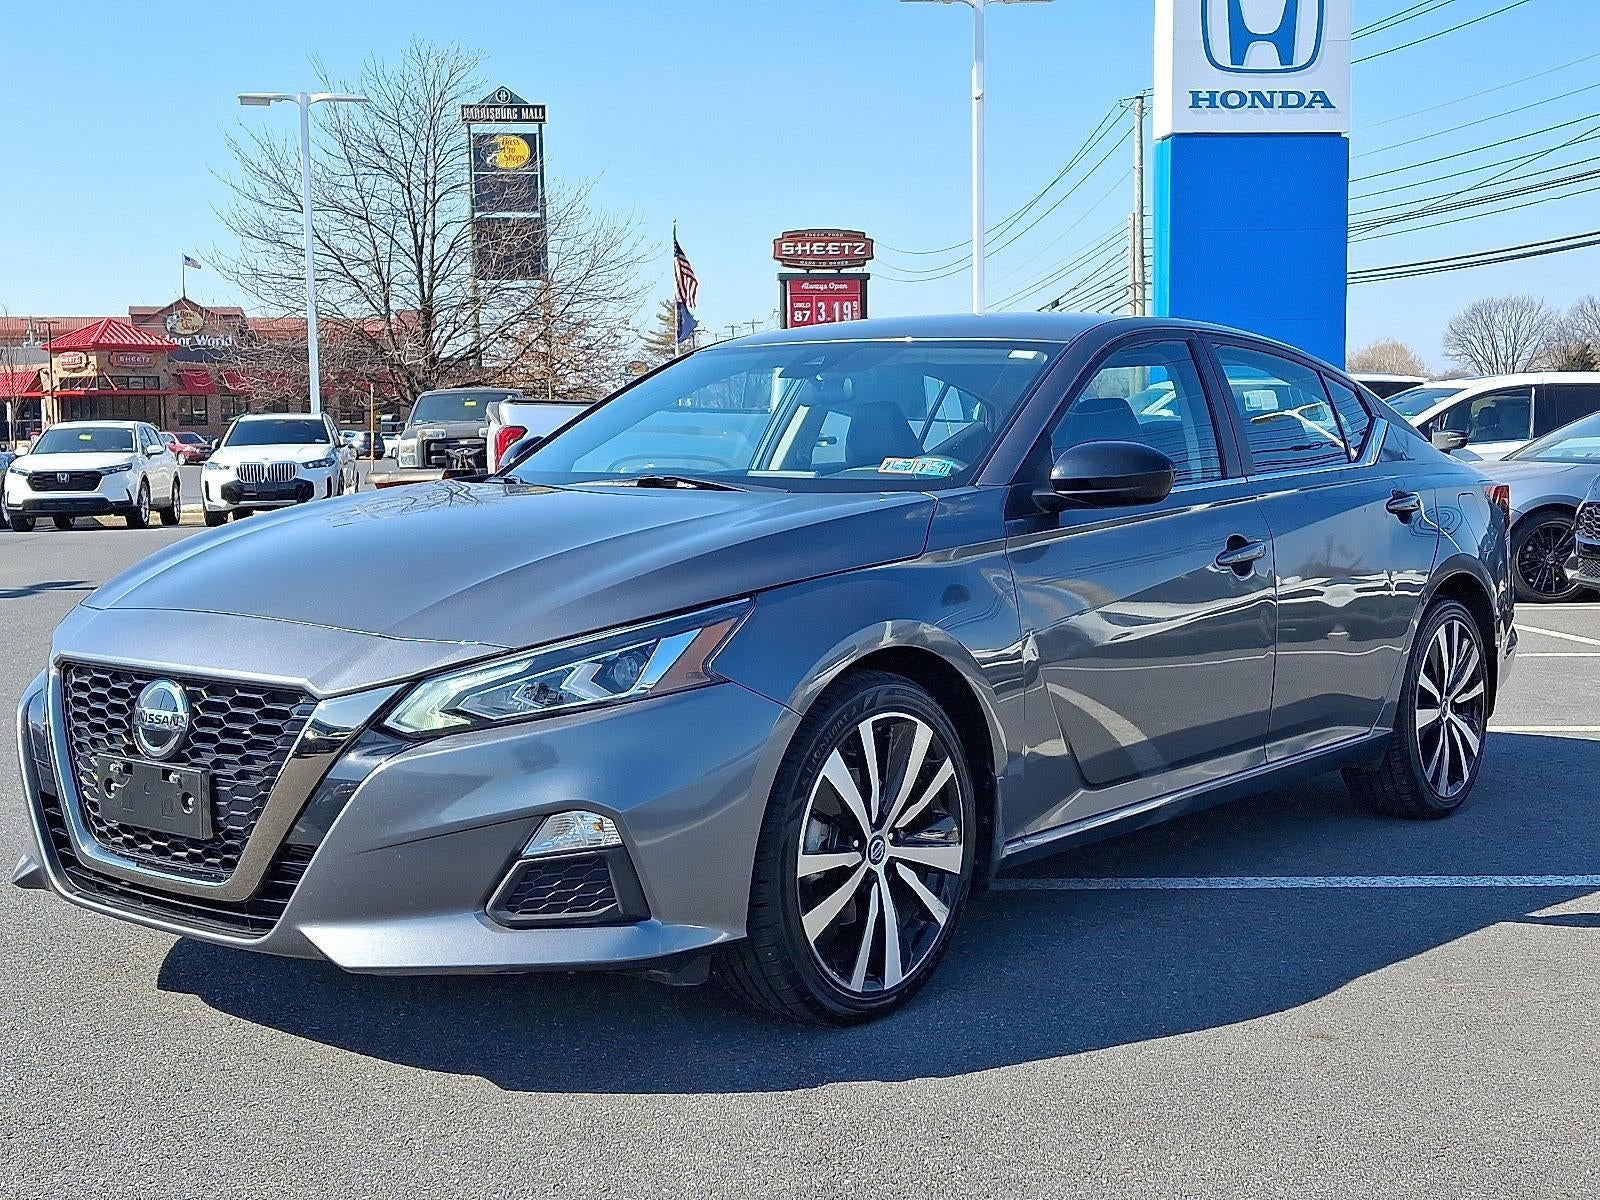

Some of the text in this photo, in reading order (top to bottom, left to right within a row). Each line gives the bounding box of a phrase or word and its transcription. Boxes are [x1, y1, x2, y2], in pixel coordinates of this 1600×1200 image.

[1188, 90, 1336, 110] HONDA
[463, 107, 545, 120] HARRISBURG MALL
[781, 242, 866, 255] SHEETZ
[801, 282, 848, 291] Always Open
[794, 310, 811, 322] 87
[194, 334, 232, 347] World
[119, 355, 151, 363] SHEETZ
[139, 711, 179, 726] NISSAN
